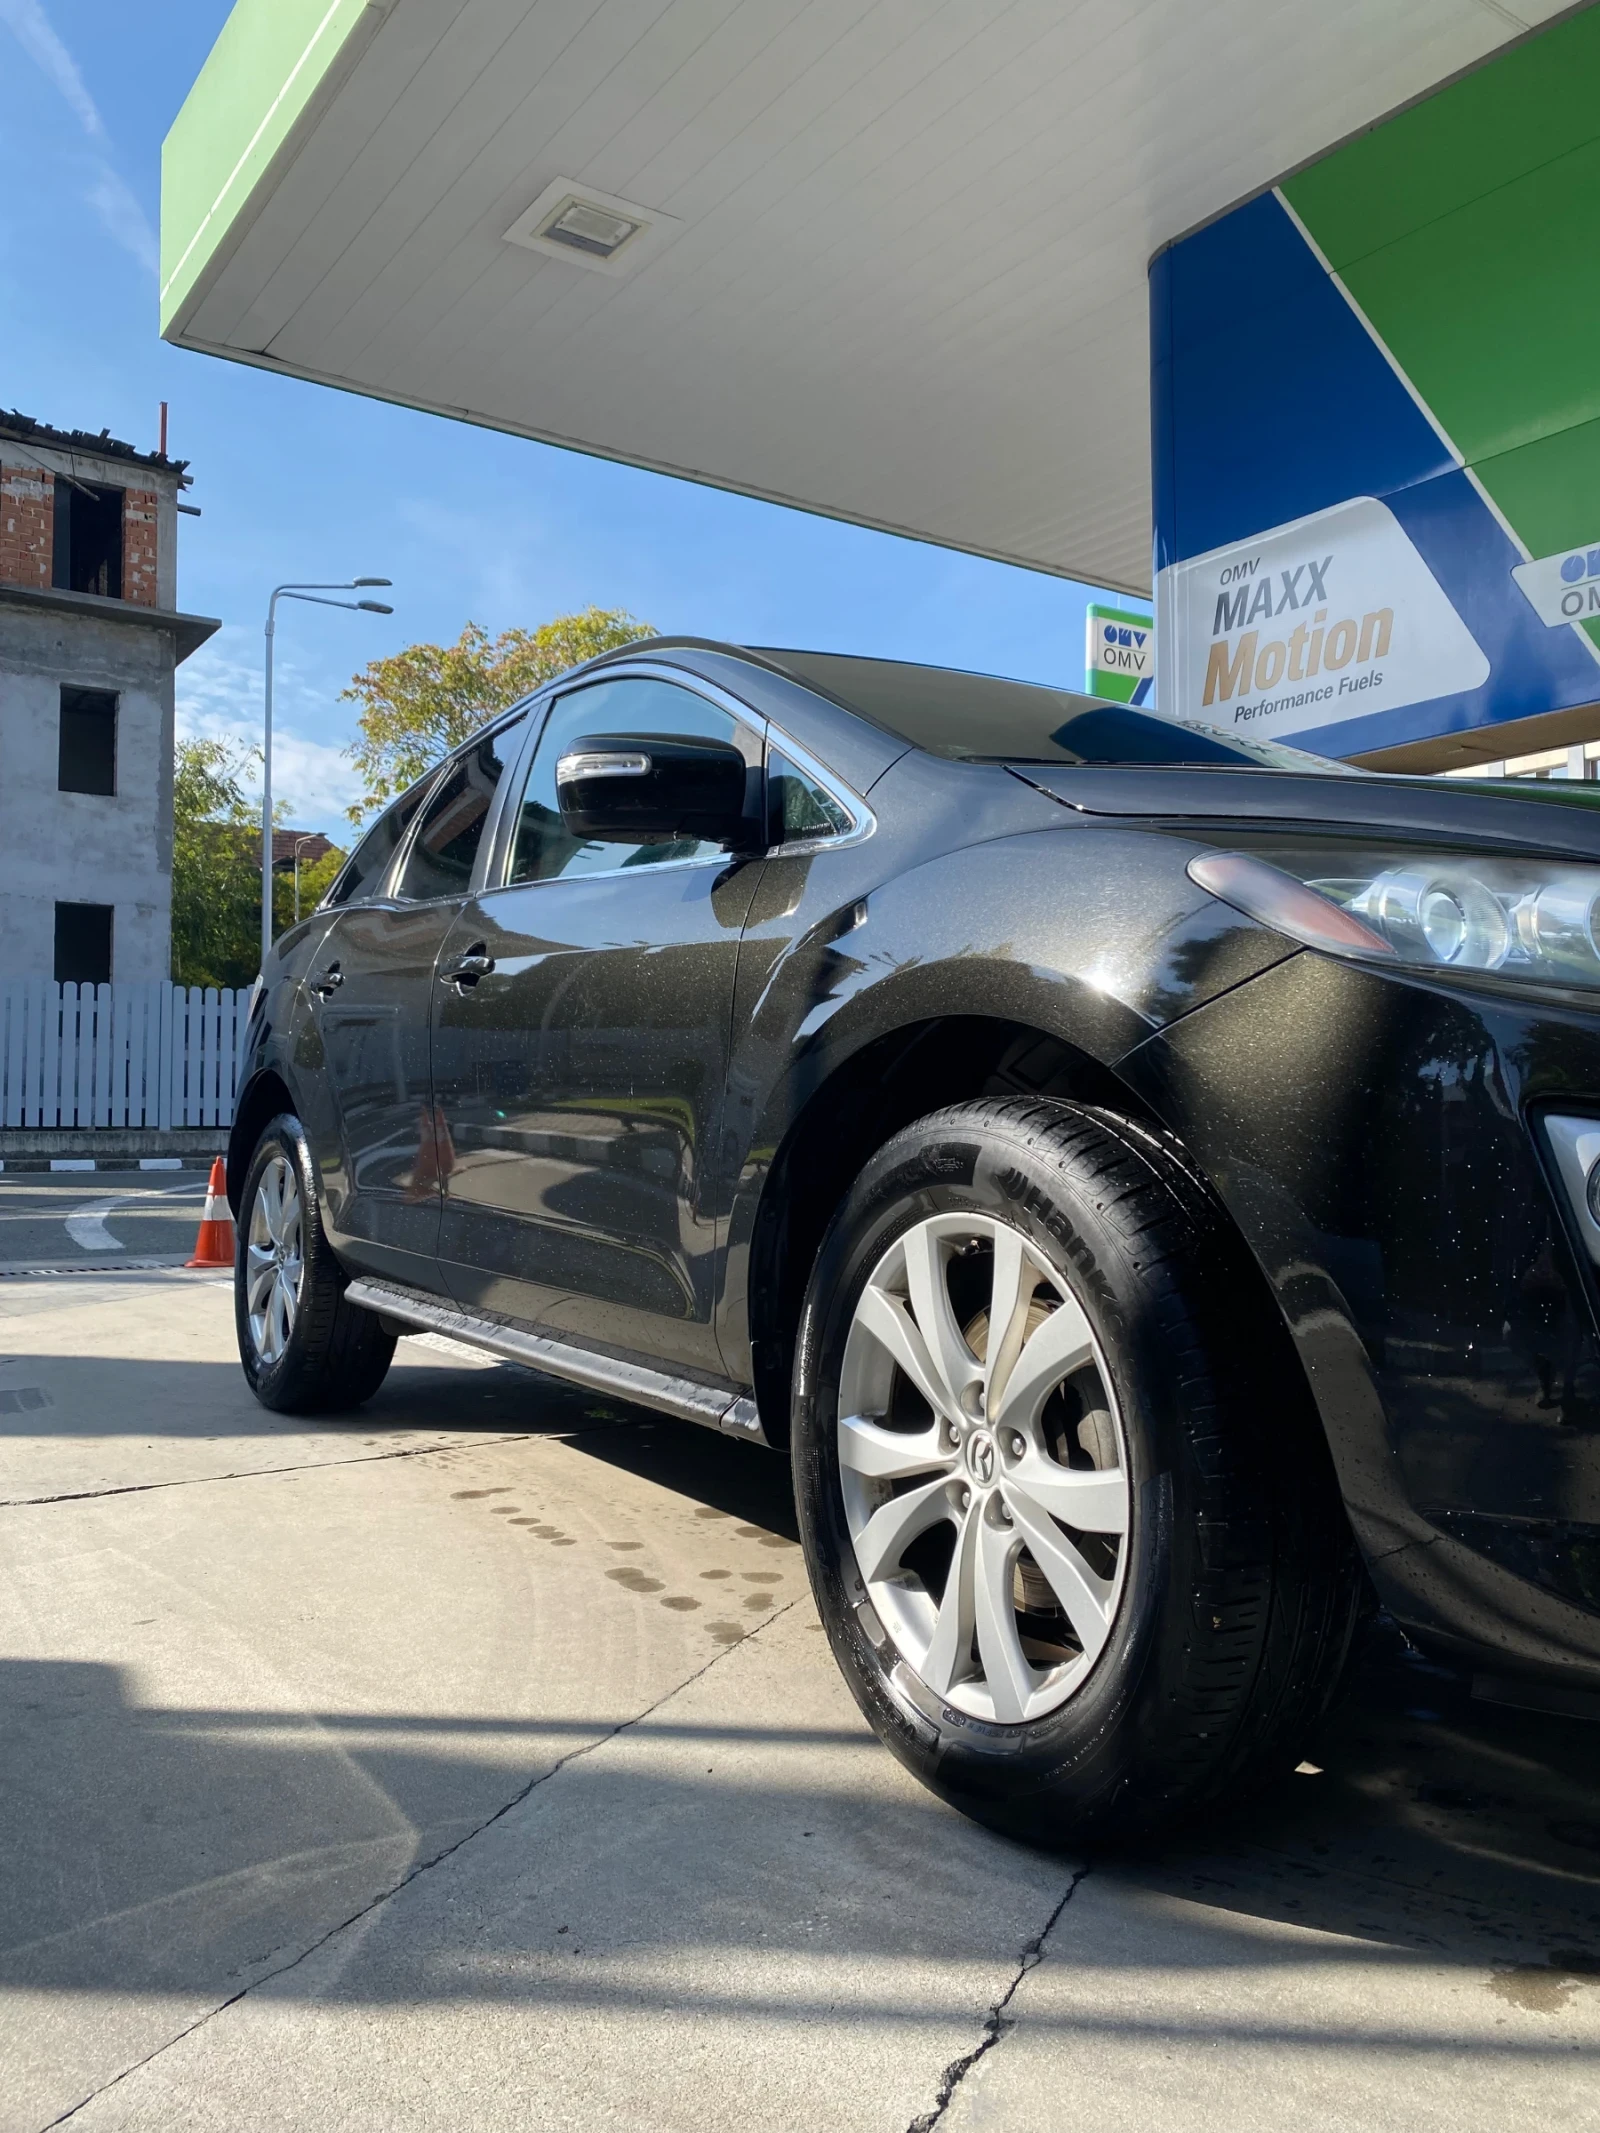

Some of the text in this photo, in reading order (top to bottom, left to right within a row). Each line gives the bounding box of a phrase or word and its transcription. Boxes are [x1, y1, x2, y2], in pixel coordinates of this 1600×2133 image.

[1213, 556, 1335, 635] MAXX
[1220, 557, 1261, 586] OMV
[1104, 647, 1145, 671] OMV
[1203, 607, 1394, 706] Motion
[1235, 669, 1384, 723] Performance Fuels
